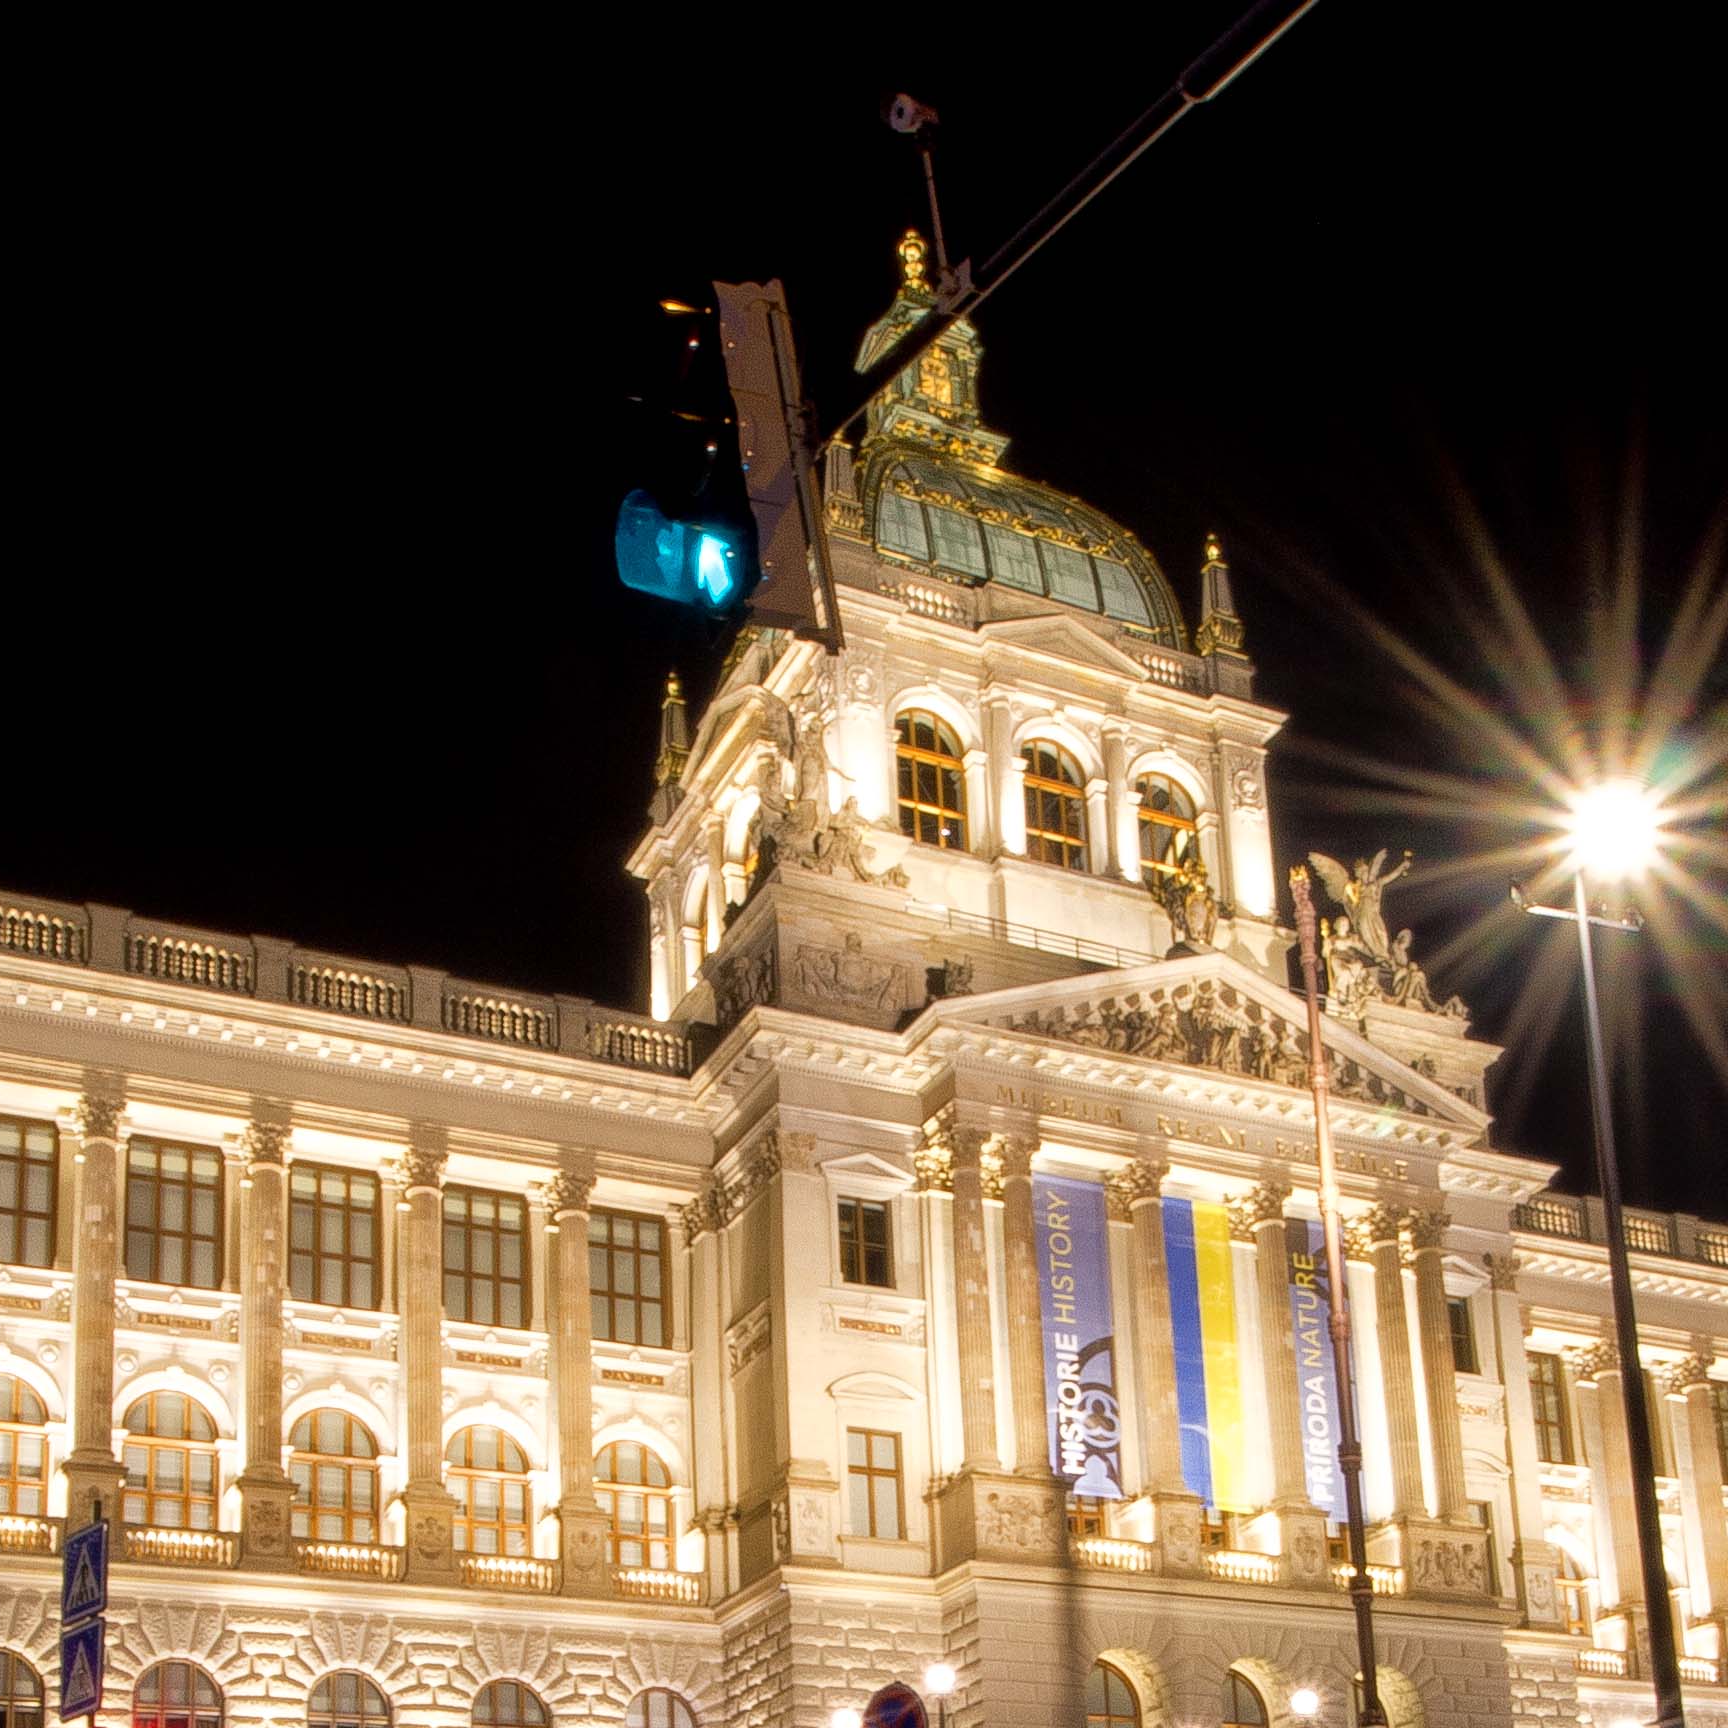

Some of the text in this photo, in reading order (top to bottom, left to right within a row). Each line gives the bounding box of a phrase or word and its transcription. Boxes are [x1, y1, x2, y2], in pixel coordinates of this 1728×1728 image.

[996, 1085, 1123, 1124] MUSEUM
[1156, 1113, 1246, 1148] REGNI
[1047, 1190, 1087, 1475] HISTORIE HISTORY
[1292, 1251, 1325, 1371] NATURE
